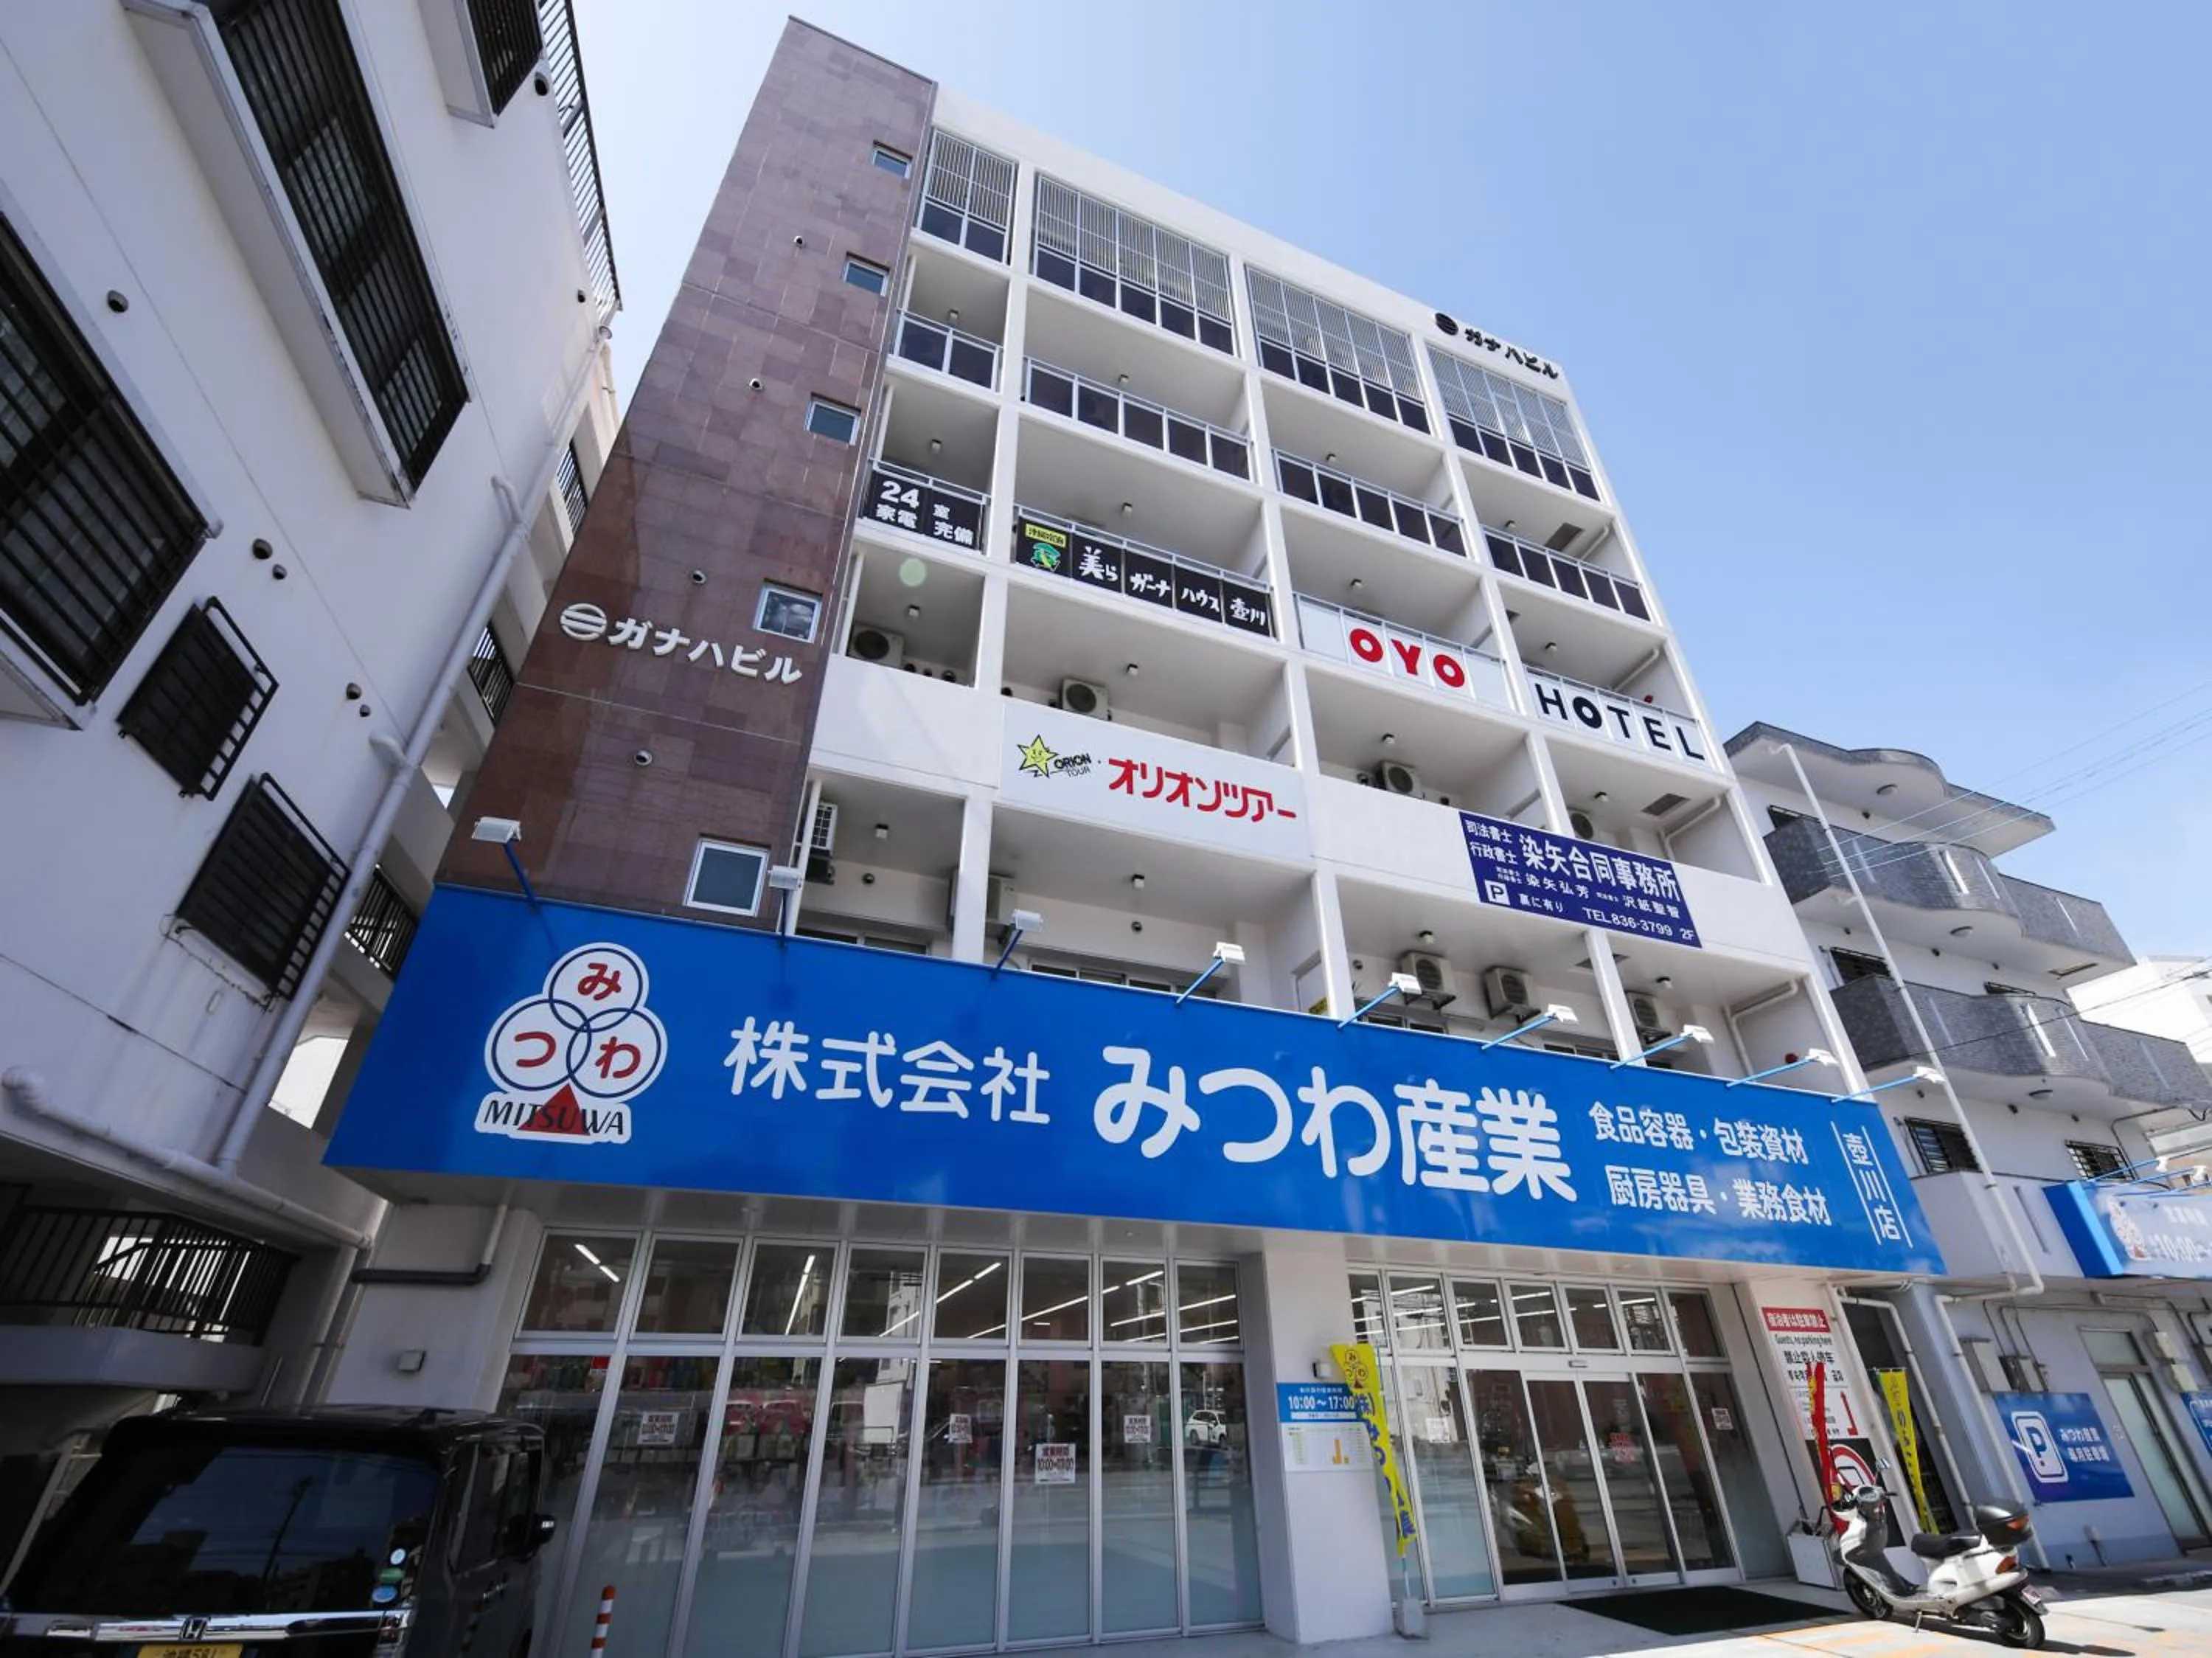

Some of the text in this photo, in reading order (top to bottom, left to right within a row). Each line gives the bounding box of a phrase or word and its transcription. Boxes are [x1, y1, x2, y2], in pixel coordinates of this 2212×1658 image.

[1465, 328, 1559, 379] ガナハビル
[880, 480, 919, 509] 24
[608, 617, 802, 684] ガナハビル
[1349, 628, 1465, 688] OYO
[1534, 684, 1705, 760] HOTEL
[1054, 752, 1091, 769] ORION
[1065, 766, 1091, 777] TOUR
[1108, 757, 1297, 822] オリオンツアー
[1465, 819, 1512, 844] 司法書士
[1470, 842, 1518, 865] 行政書士
[1519, 833, 1680, 902] 染矢合同事務所
[1489, 884, 1504, 900] P
[1680, 928, 1695, 940] 2F
[578, 962, 622, 1001] み
[515, 1031, 641, 1078] つ わ
[723, 1016, 1051, 1124] 株式会社
[484, 1100, 624, 1136] MITSUWA
[1093, 1046, 1577, 1202] みつわ産業
[1588, 1100, 1809, 1165] 食品容器・包装資材
